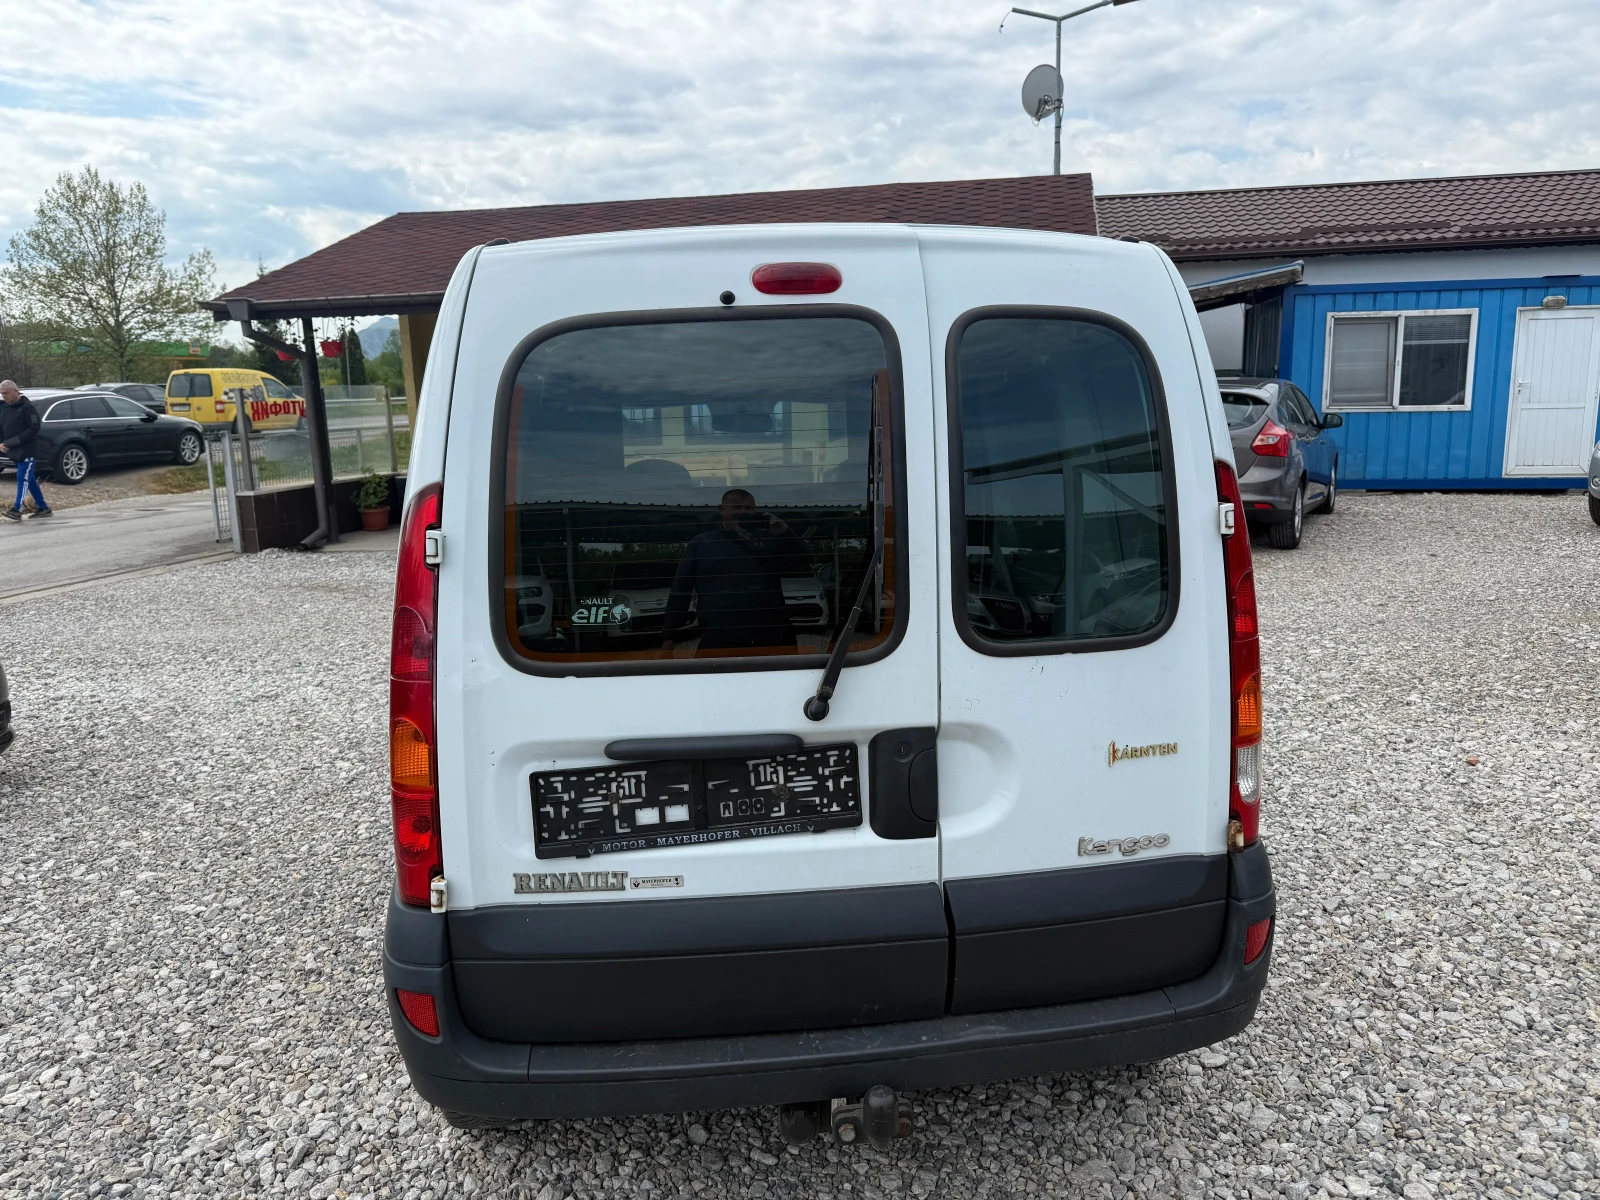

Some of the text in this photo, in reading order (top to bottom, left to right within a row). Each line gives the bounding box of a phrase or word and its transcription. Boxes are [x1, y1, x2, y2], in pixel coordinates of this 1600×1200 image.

[571, 606, 610, 623] elf
[602, 838, 647, 852] MOTOR
[656, 829, 741, 847] MAYERHOFER
[749, 823, 801, 837] VILLACH
[1077, 832, 1171, 857] Kangoo
[513, 871, 629, 894] RENAULT
